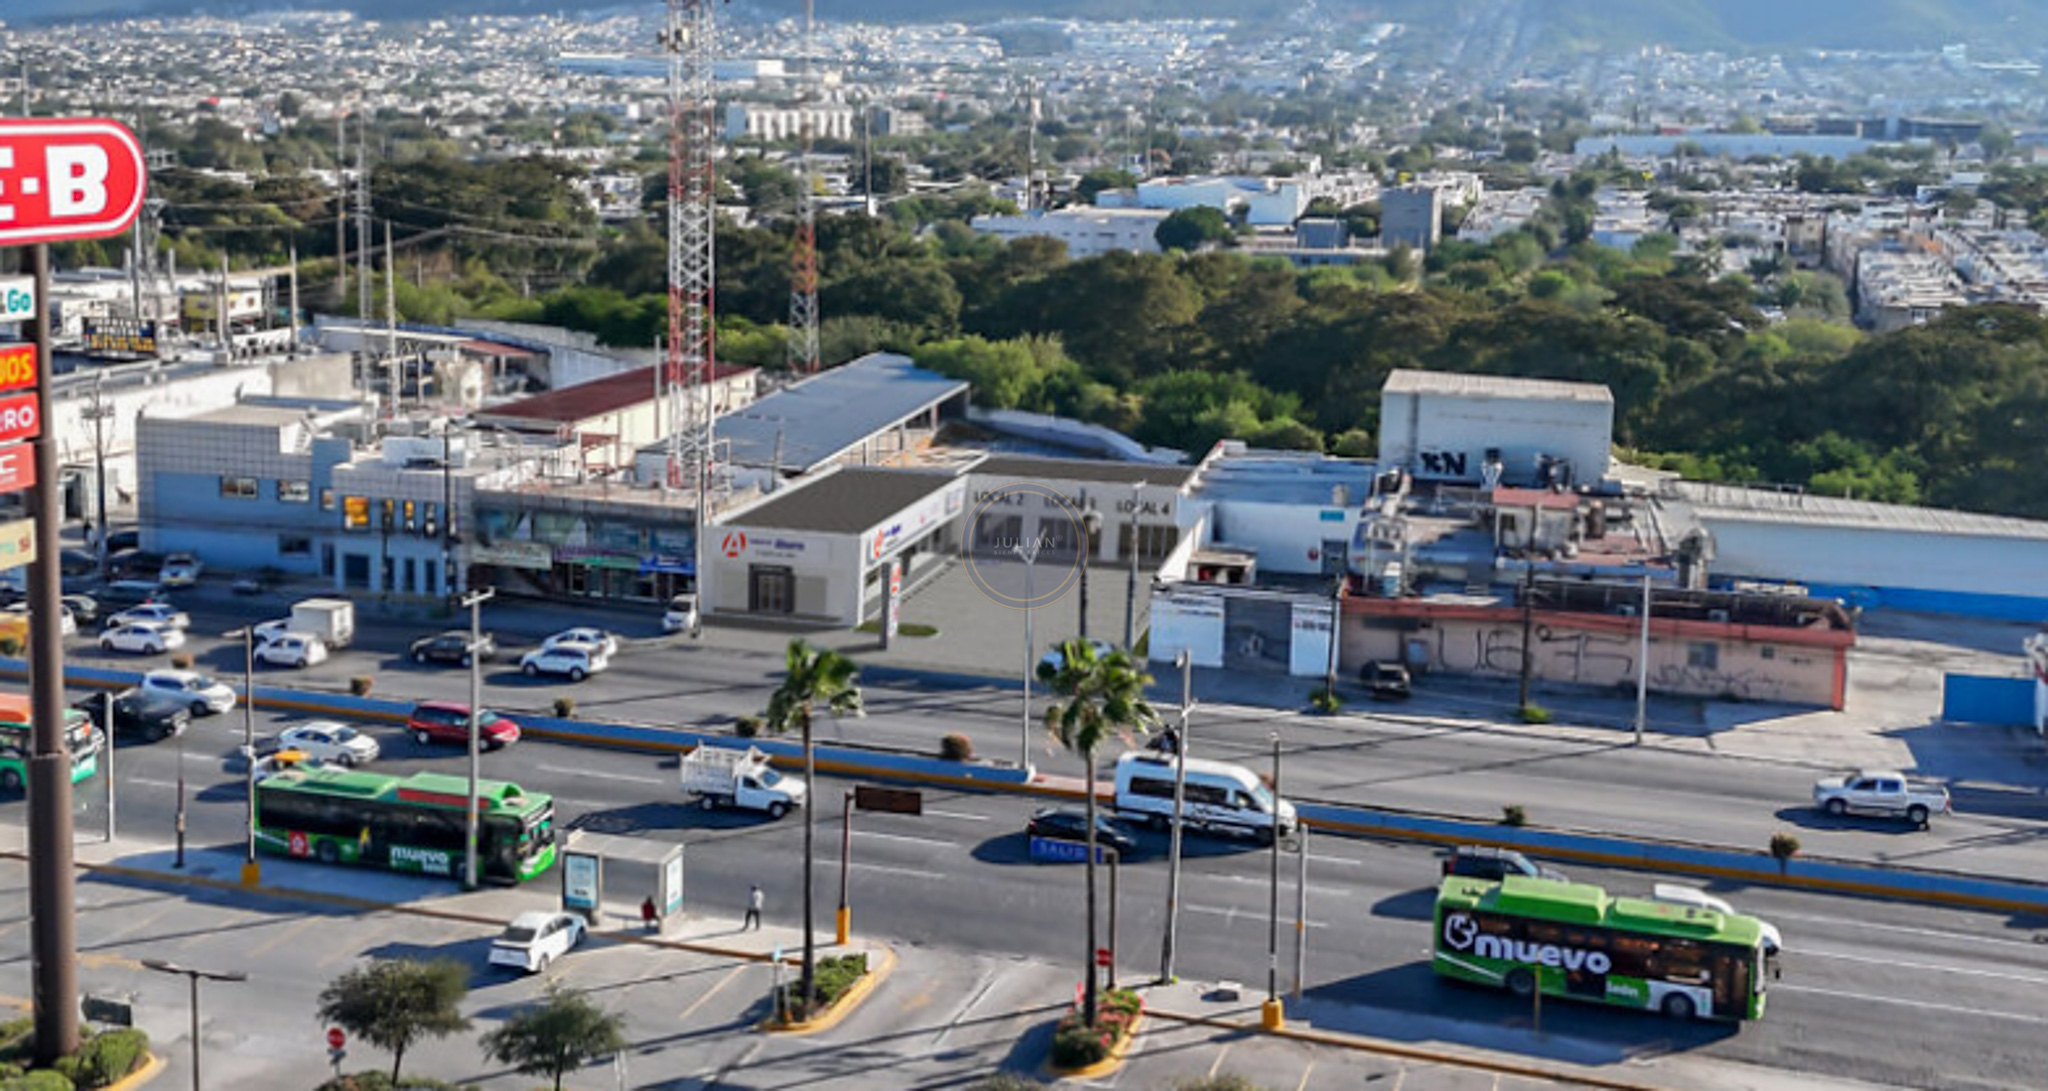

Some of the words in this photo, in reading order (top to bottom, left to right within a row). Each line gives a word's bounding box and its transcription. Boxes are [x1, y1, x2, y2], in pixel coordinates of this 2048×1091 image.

[0, 405, 36, 432] RO
[1116, 499, 1158, 515] LOAL
[1038, 841, 1089, 858] SALID
[1474, 933, 1612, 975] muevo
